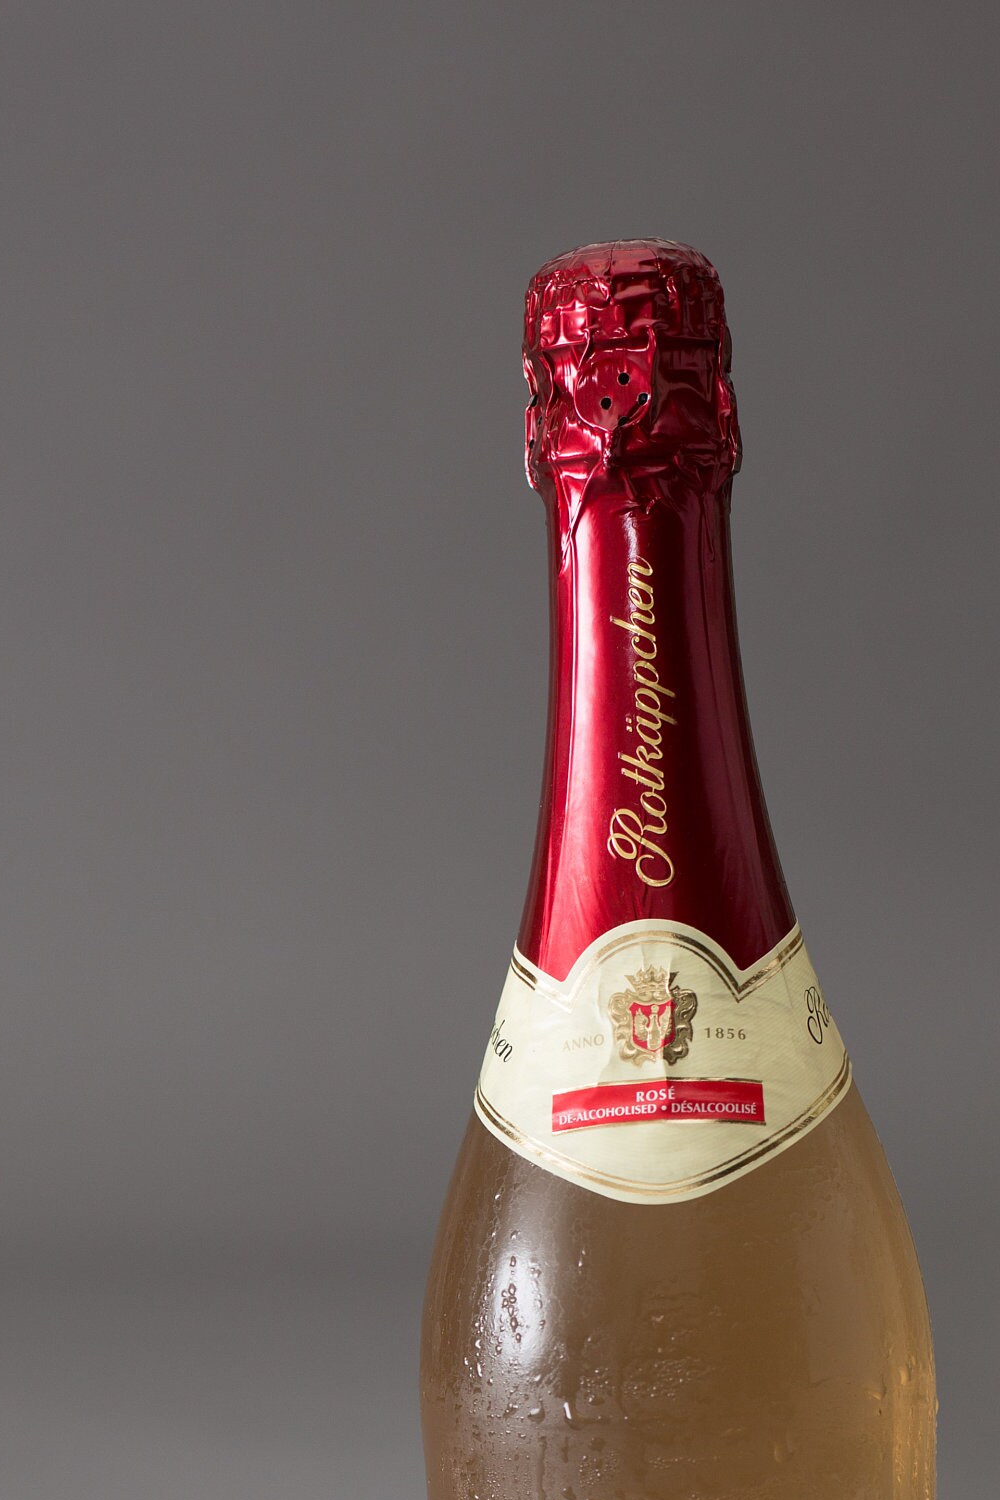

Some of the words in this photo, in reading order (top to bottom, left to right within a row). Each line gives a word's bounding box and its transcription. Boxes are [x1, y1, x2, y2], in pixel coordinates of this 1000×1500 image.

[607, 556, 678, 888] Rotkäppchen
[561, 1034, 605, 1053] ANNO
[704, 1026, 747, 1041] 1856
[635, 1085, 676, 1103] ROSÉ
[558, 1104, 657, 1126] DE-ALCOHOLISED
[671, 1101, 757, 1115] DÉSALCOOLISÉ
